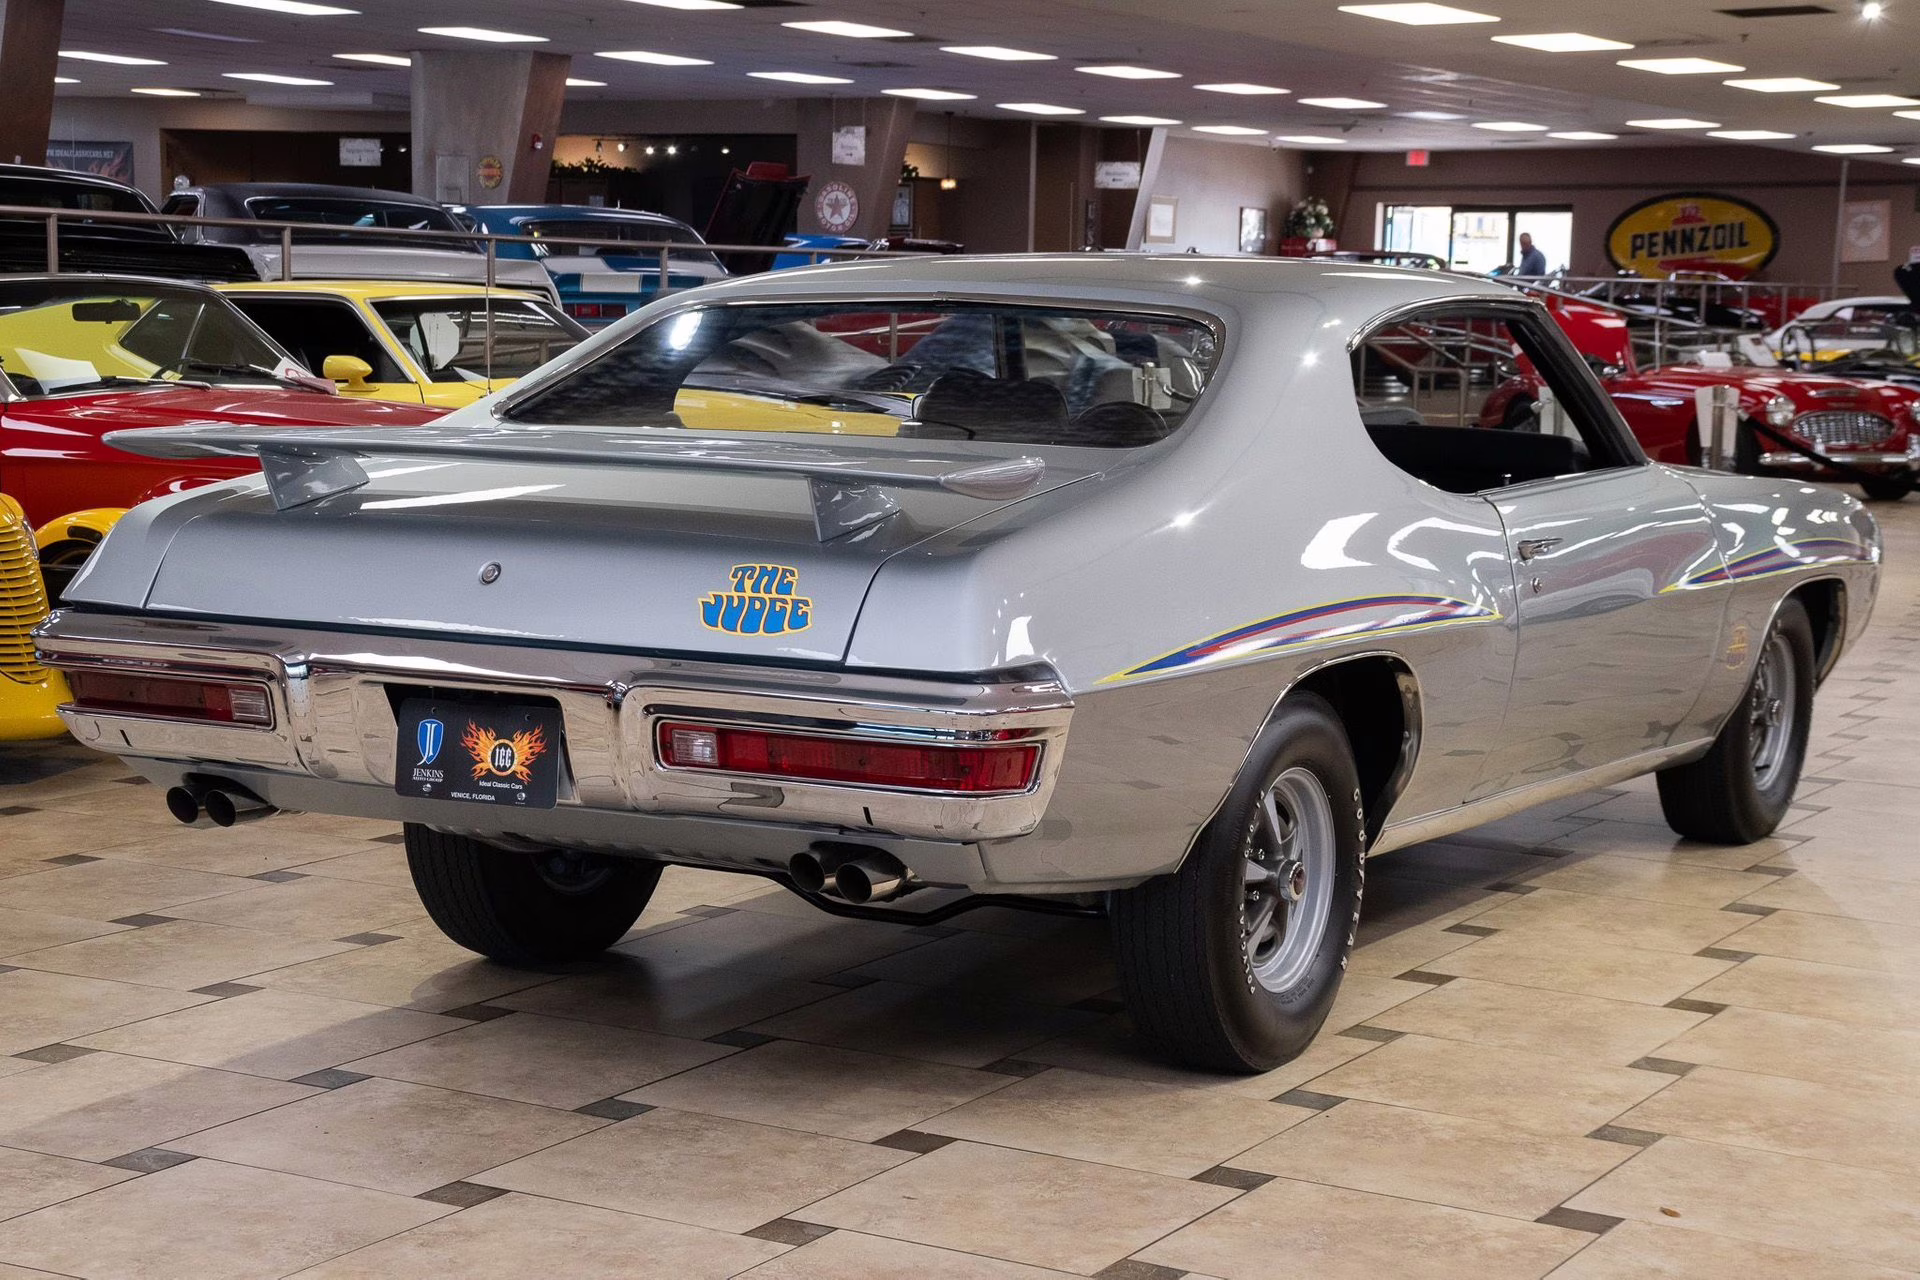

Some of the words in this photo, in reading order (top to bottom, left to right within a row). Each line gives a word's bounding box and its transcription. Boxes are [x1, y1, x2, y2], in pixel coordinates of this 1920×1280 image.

[1631, 222, 1749, 259] PENNZOIL
[730, 564, 798, 596] THE
[699, 593, 812, 635] JUDGE
[494, 747, 512, 769] ICC
[412, 768, 444, 779] JENKINS
[492, 781, 510, 789] Classic
[511, 782, 523, 790] Cars
[450, 791, 471, 800] VENICE,
[472, 792, 496, 801] FLORIDA
[1340, 787, 1366, 972] GOODYEAR
